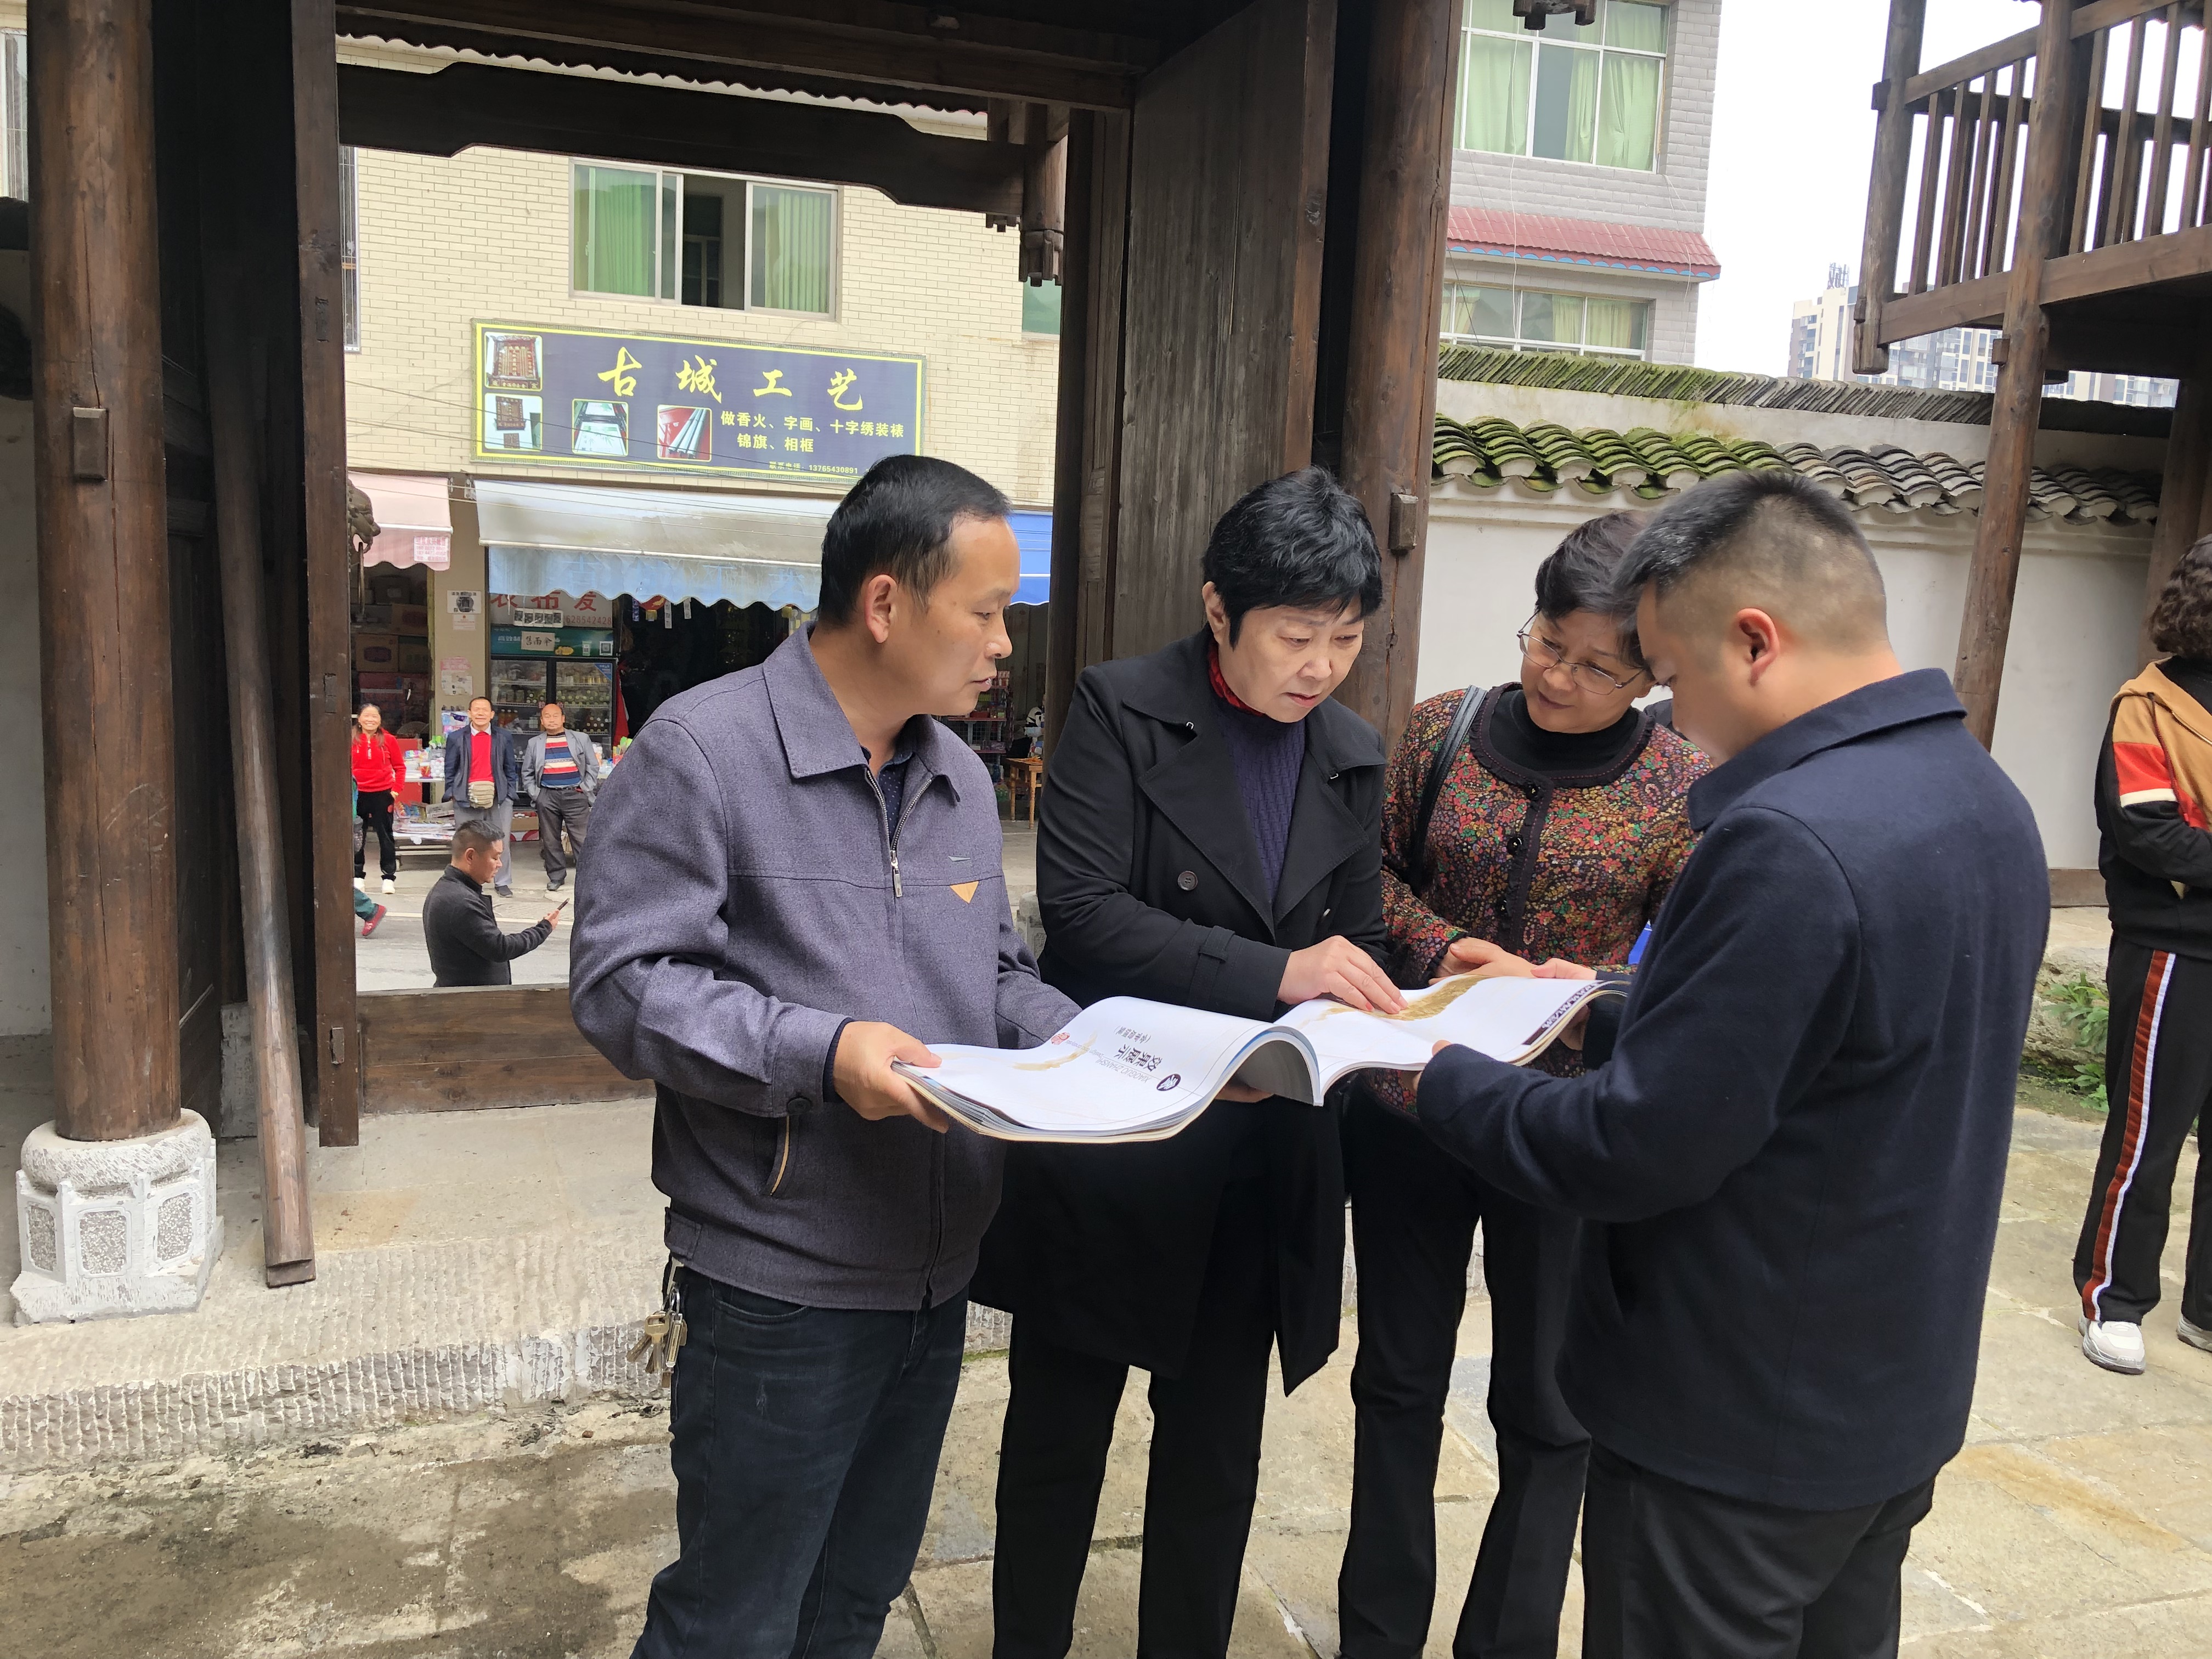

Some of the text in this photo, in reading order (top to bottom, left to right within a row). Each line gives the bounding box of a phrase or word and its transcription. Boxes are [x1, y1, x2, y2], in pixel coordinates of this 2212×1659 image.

[598, 347, 863, 410] 古城工艺
[721, 410, 904, 438] 做香火、字画、十字绣装裱
[737, 433, 814, 453] 锦旗、相框
[809, 464, 858, 475] 13765430891
[563, 614, 612, 625] 628542428
[1096, 1057, 1122, 1072] ZHANSHI
[1113, 1043, 1163, 1072] 效果展示
[1121, 1067, 1152, 1084] XIAOGUO
